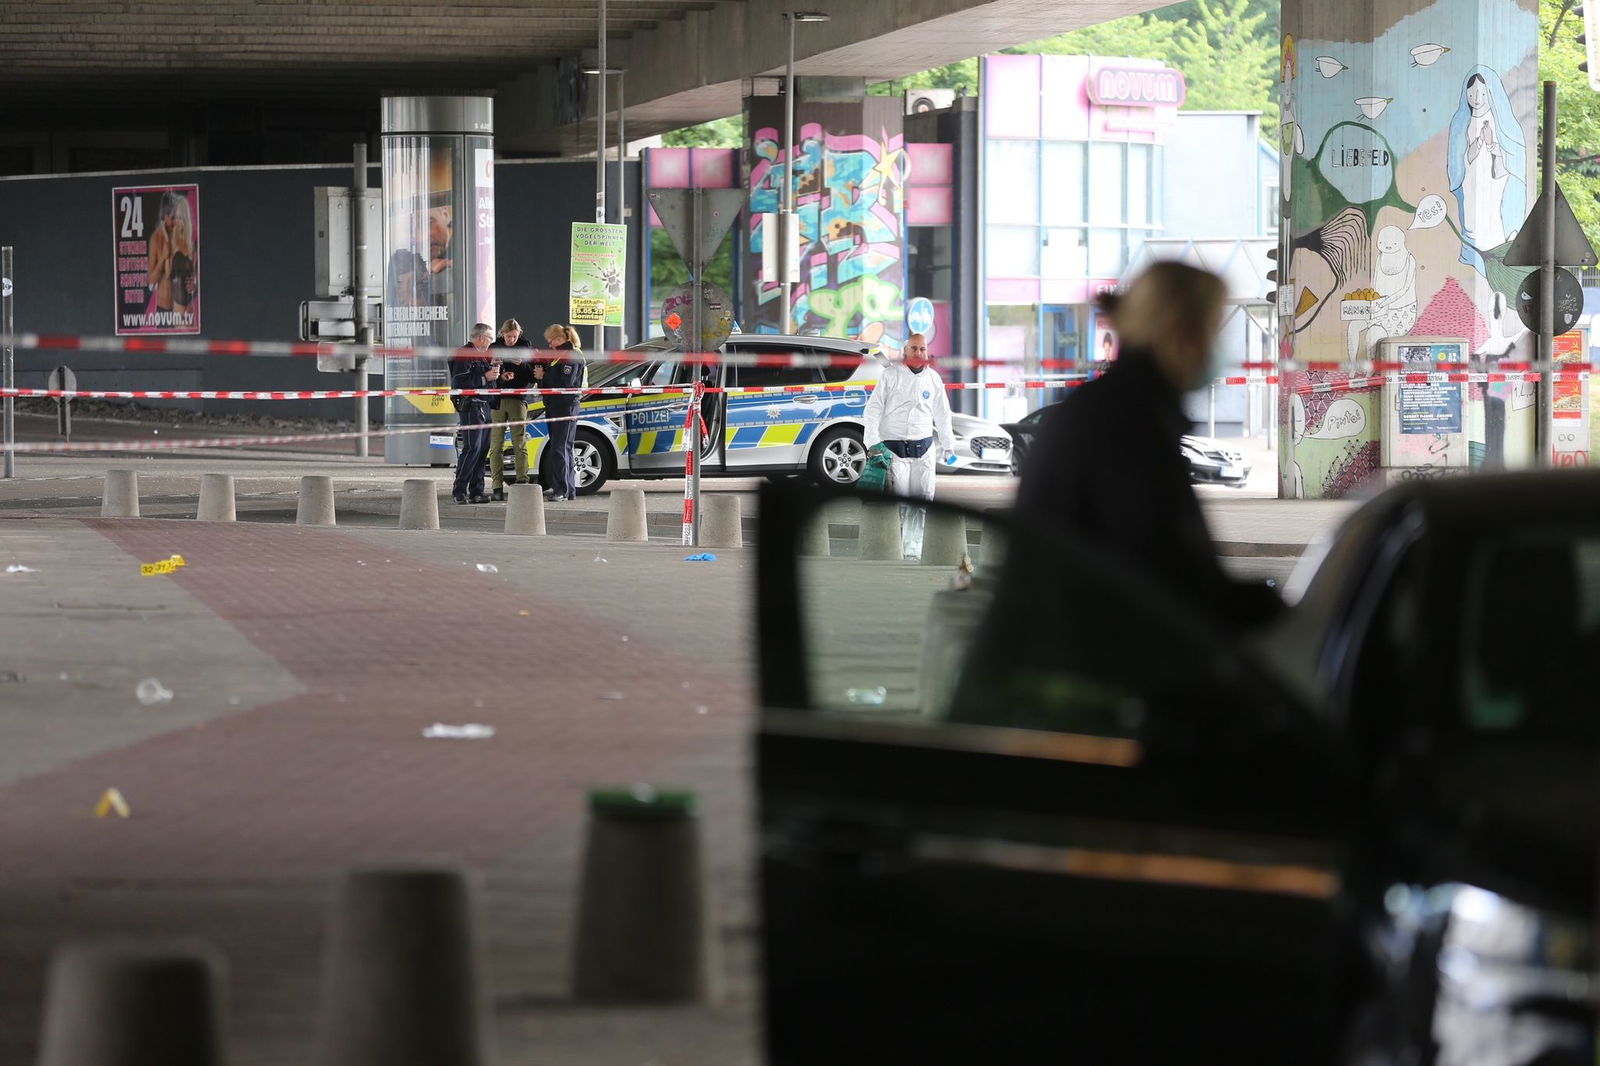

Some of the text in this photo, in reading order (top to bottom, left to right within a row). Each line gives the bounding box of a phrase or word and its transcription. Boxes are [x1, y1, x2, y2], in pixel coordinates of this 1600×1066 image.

[120, 196, 144, 238] 24
[122, 311, 194, 327] www.novum.tv
[631, 410, 670, 425] POLIZEI
